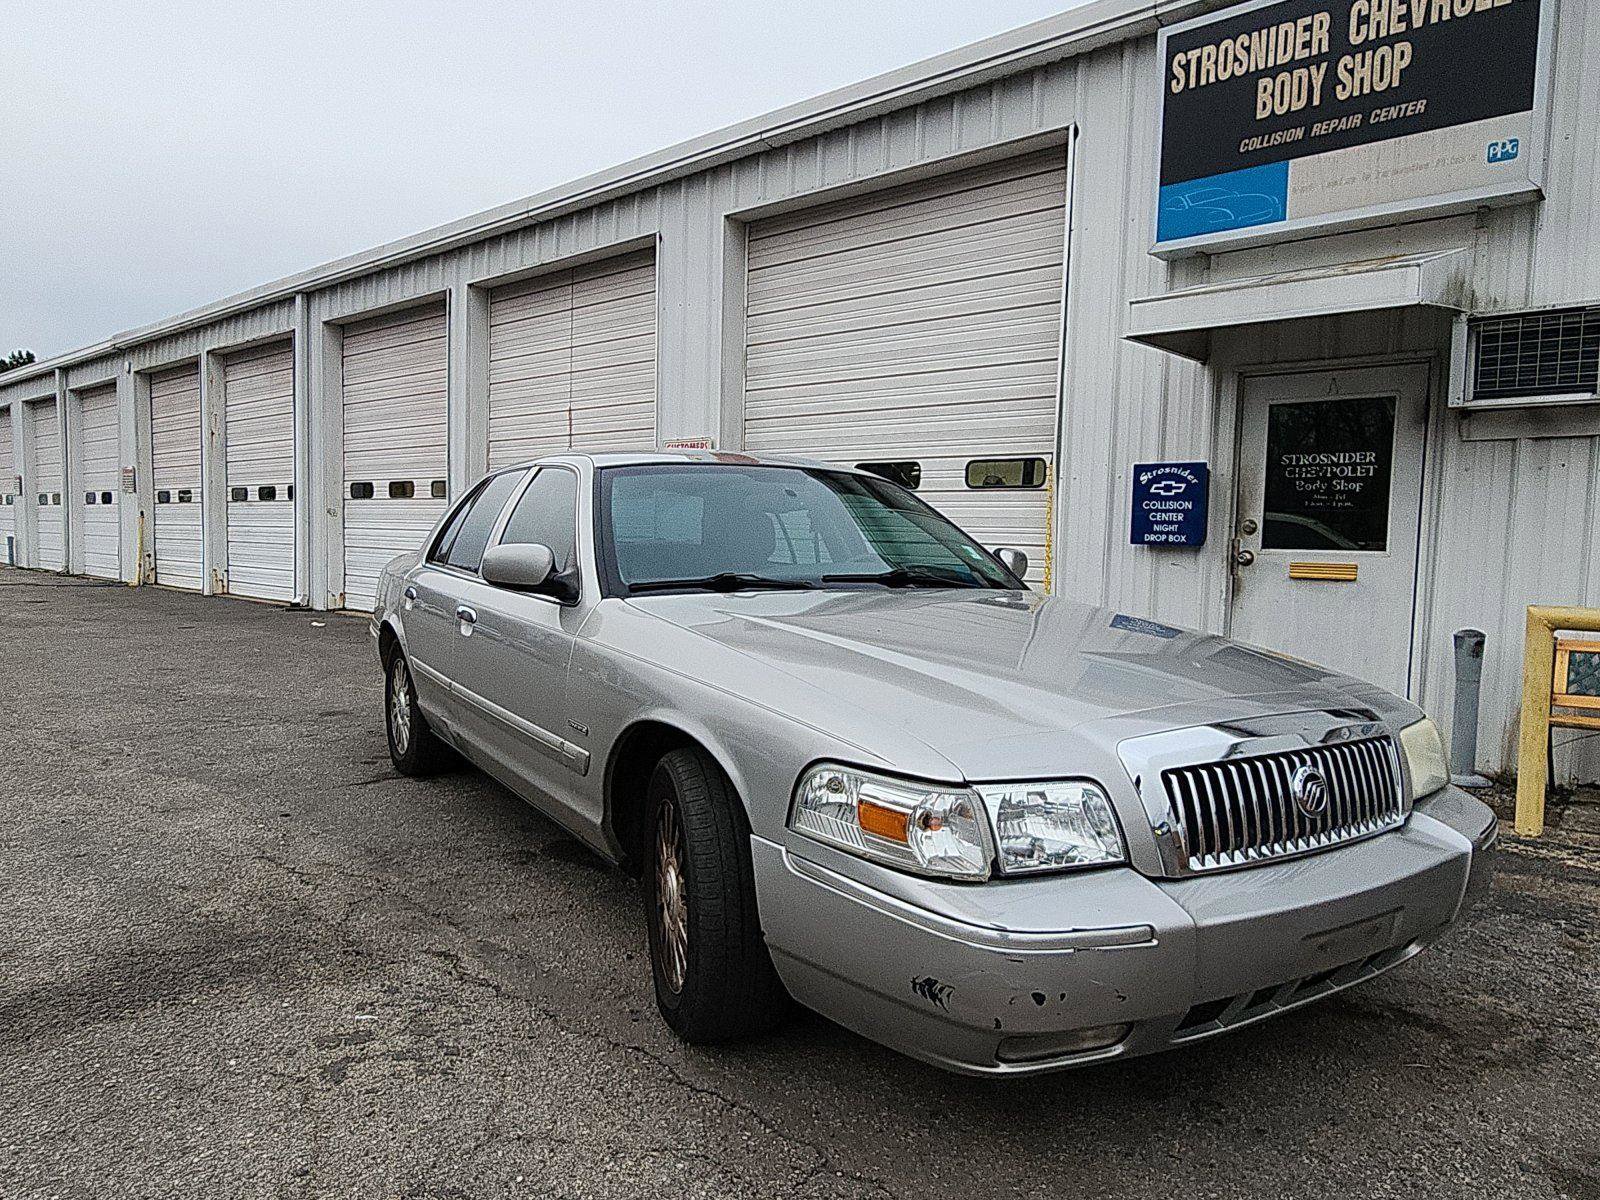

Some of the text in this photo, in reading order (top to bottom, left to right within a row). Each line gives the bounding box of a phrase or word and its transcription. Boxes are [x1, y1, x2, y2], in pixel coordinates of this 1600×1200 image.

[1171, 11, 1331, 94] STROSNIDER
[1256, 41, 1412, 120] BODY SHOP
[1239, 99, 1428, 153] COLLISION REPAIR CENTER
[1489, 138, 1518, 159] PPG
[1280, 451, 1377, 466] STROSNIDER
[1139, 466, 1199, 485] Strosnider
[1285, 464, 1378, 479] CHEVROLET
[1295, 478, 1364, 493] Body Shop
[1142, 500, 1193, 510] COLLISION
[1148, 512, 1185, 522] CENTER
[1153, 523, 1179, 533] NIGHT
[1143, 533, 1187, 543] DROP BOX
